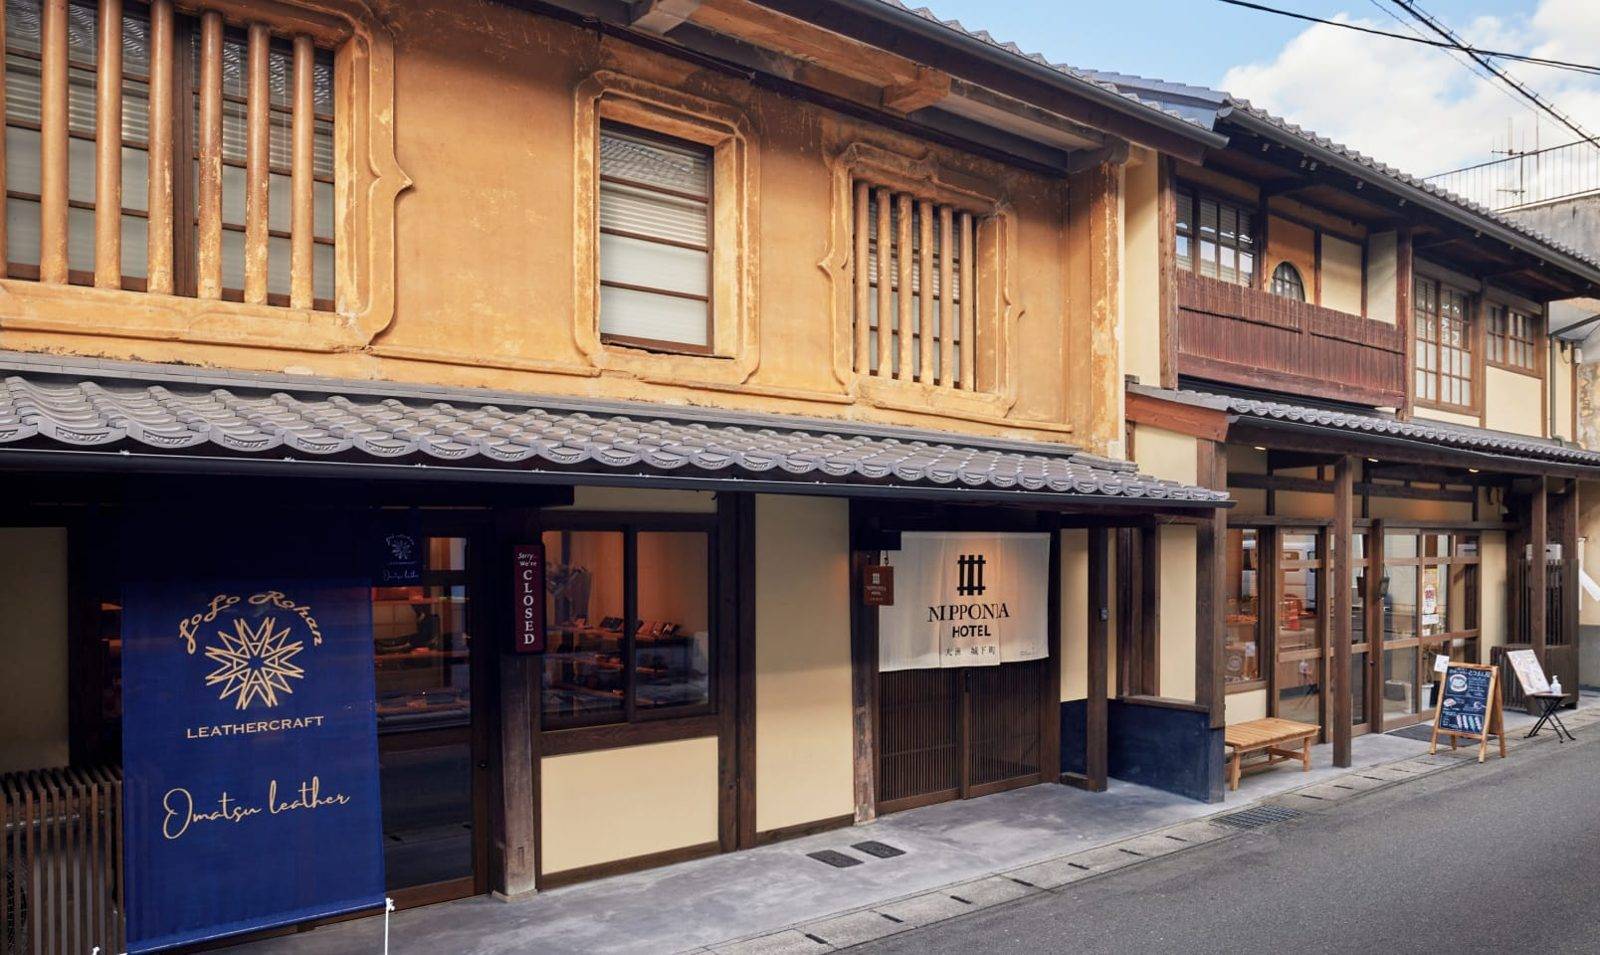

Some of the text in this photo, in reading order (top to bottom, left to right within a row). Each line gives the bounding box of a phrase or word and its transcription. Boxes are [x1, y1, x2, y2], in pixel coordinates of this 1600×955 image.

[247, 590, 323, 647] Rohan
[522, 569, 536, 645] CLOSED
[927, 603, 1010, 622] NIPPONIA
[952, 625, 991, 638] HOTEL
[970, 645, 996, 656] 城下町
[187, 715, 324, 739] LEATHERCRAFT
[163, 776, 351, 840] Omatsu leather
